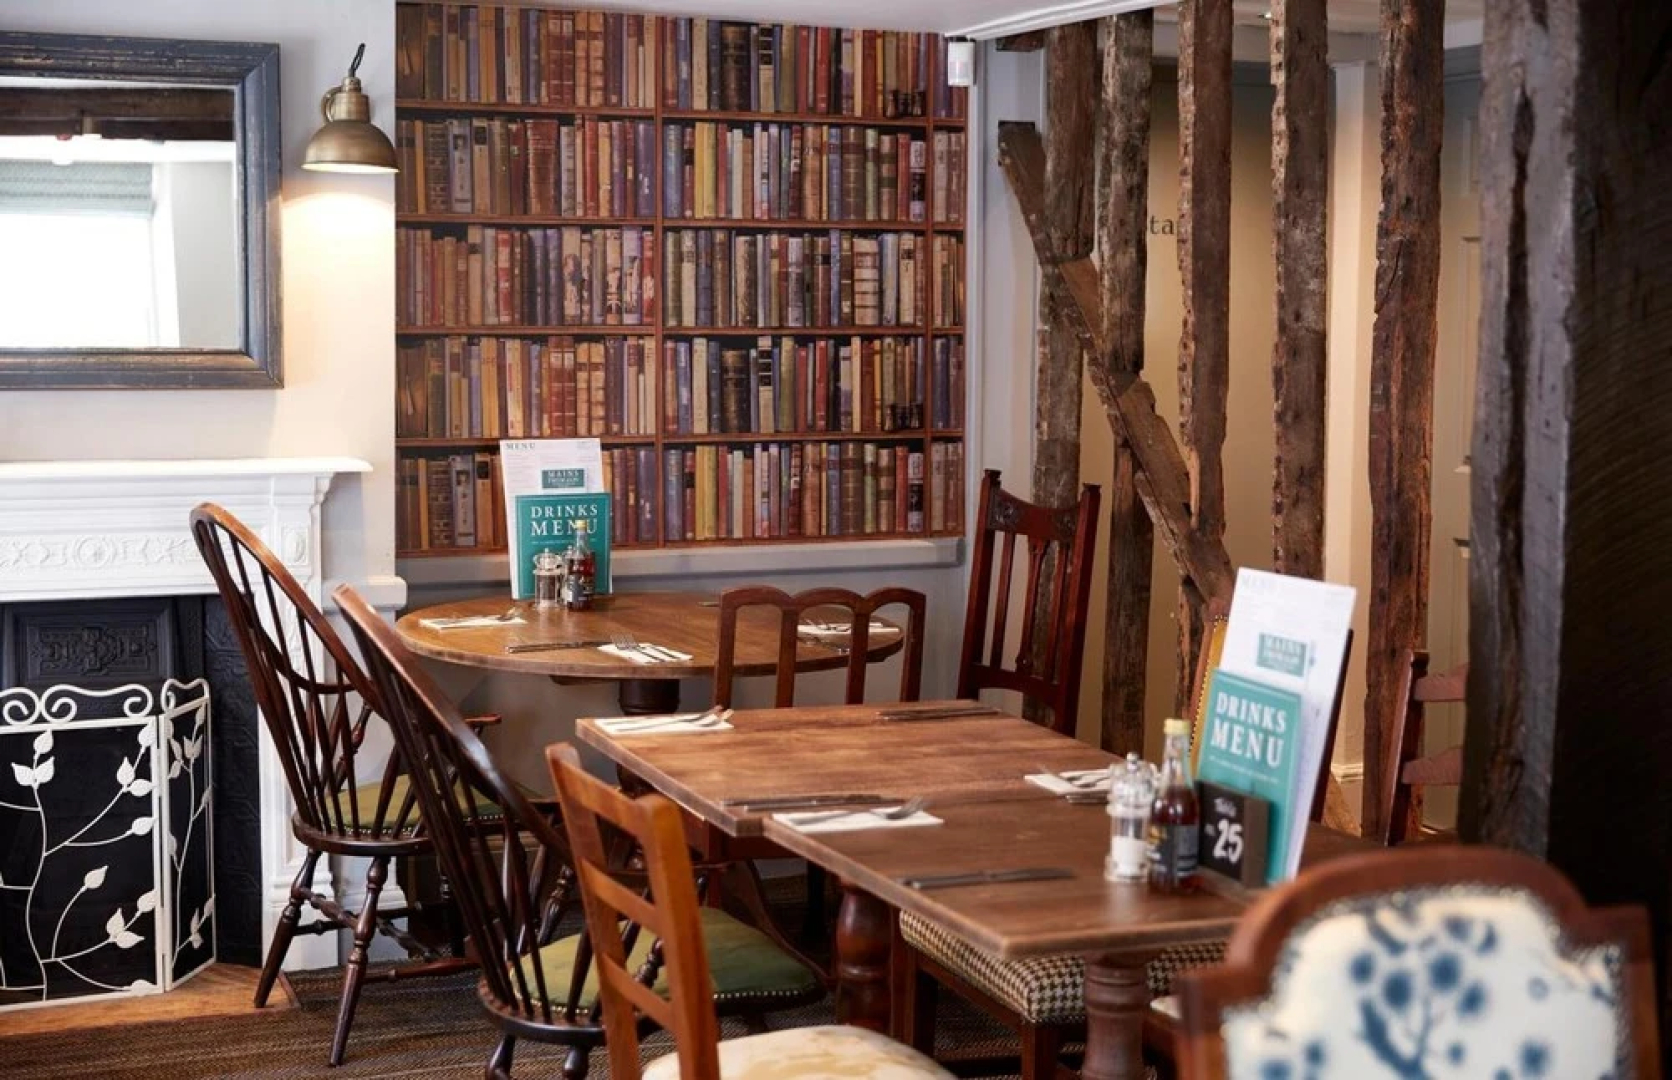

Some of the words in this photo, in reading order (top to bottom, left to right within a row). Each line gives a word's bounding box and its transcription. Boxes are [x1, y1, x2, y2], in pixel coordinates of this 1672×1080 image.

[505, 442, 536, 451] MENU
[530, 504, 598, 518] DRINKS
[530, 518, 598, 536] MENU
[1216, 691, 1287, 734] DRINKS
[1210, 717, 1284, 768] MENU
[1213, 818, 1244, 865] 25
